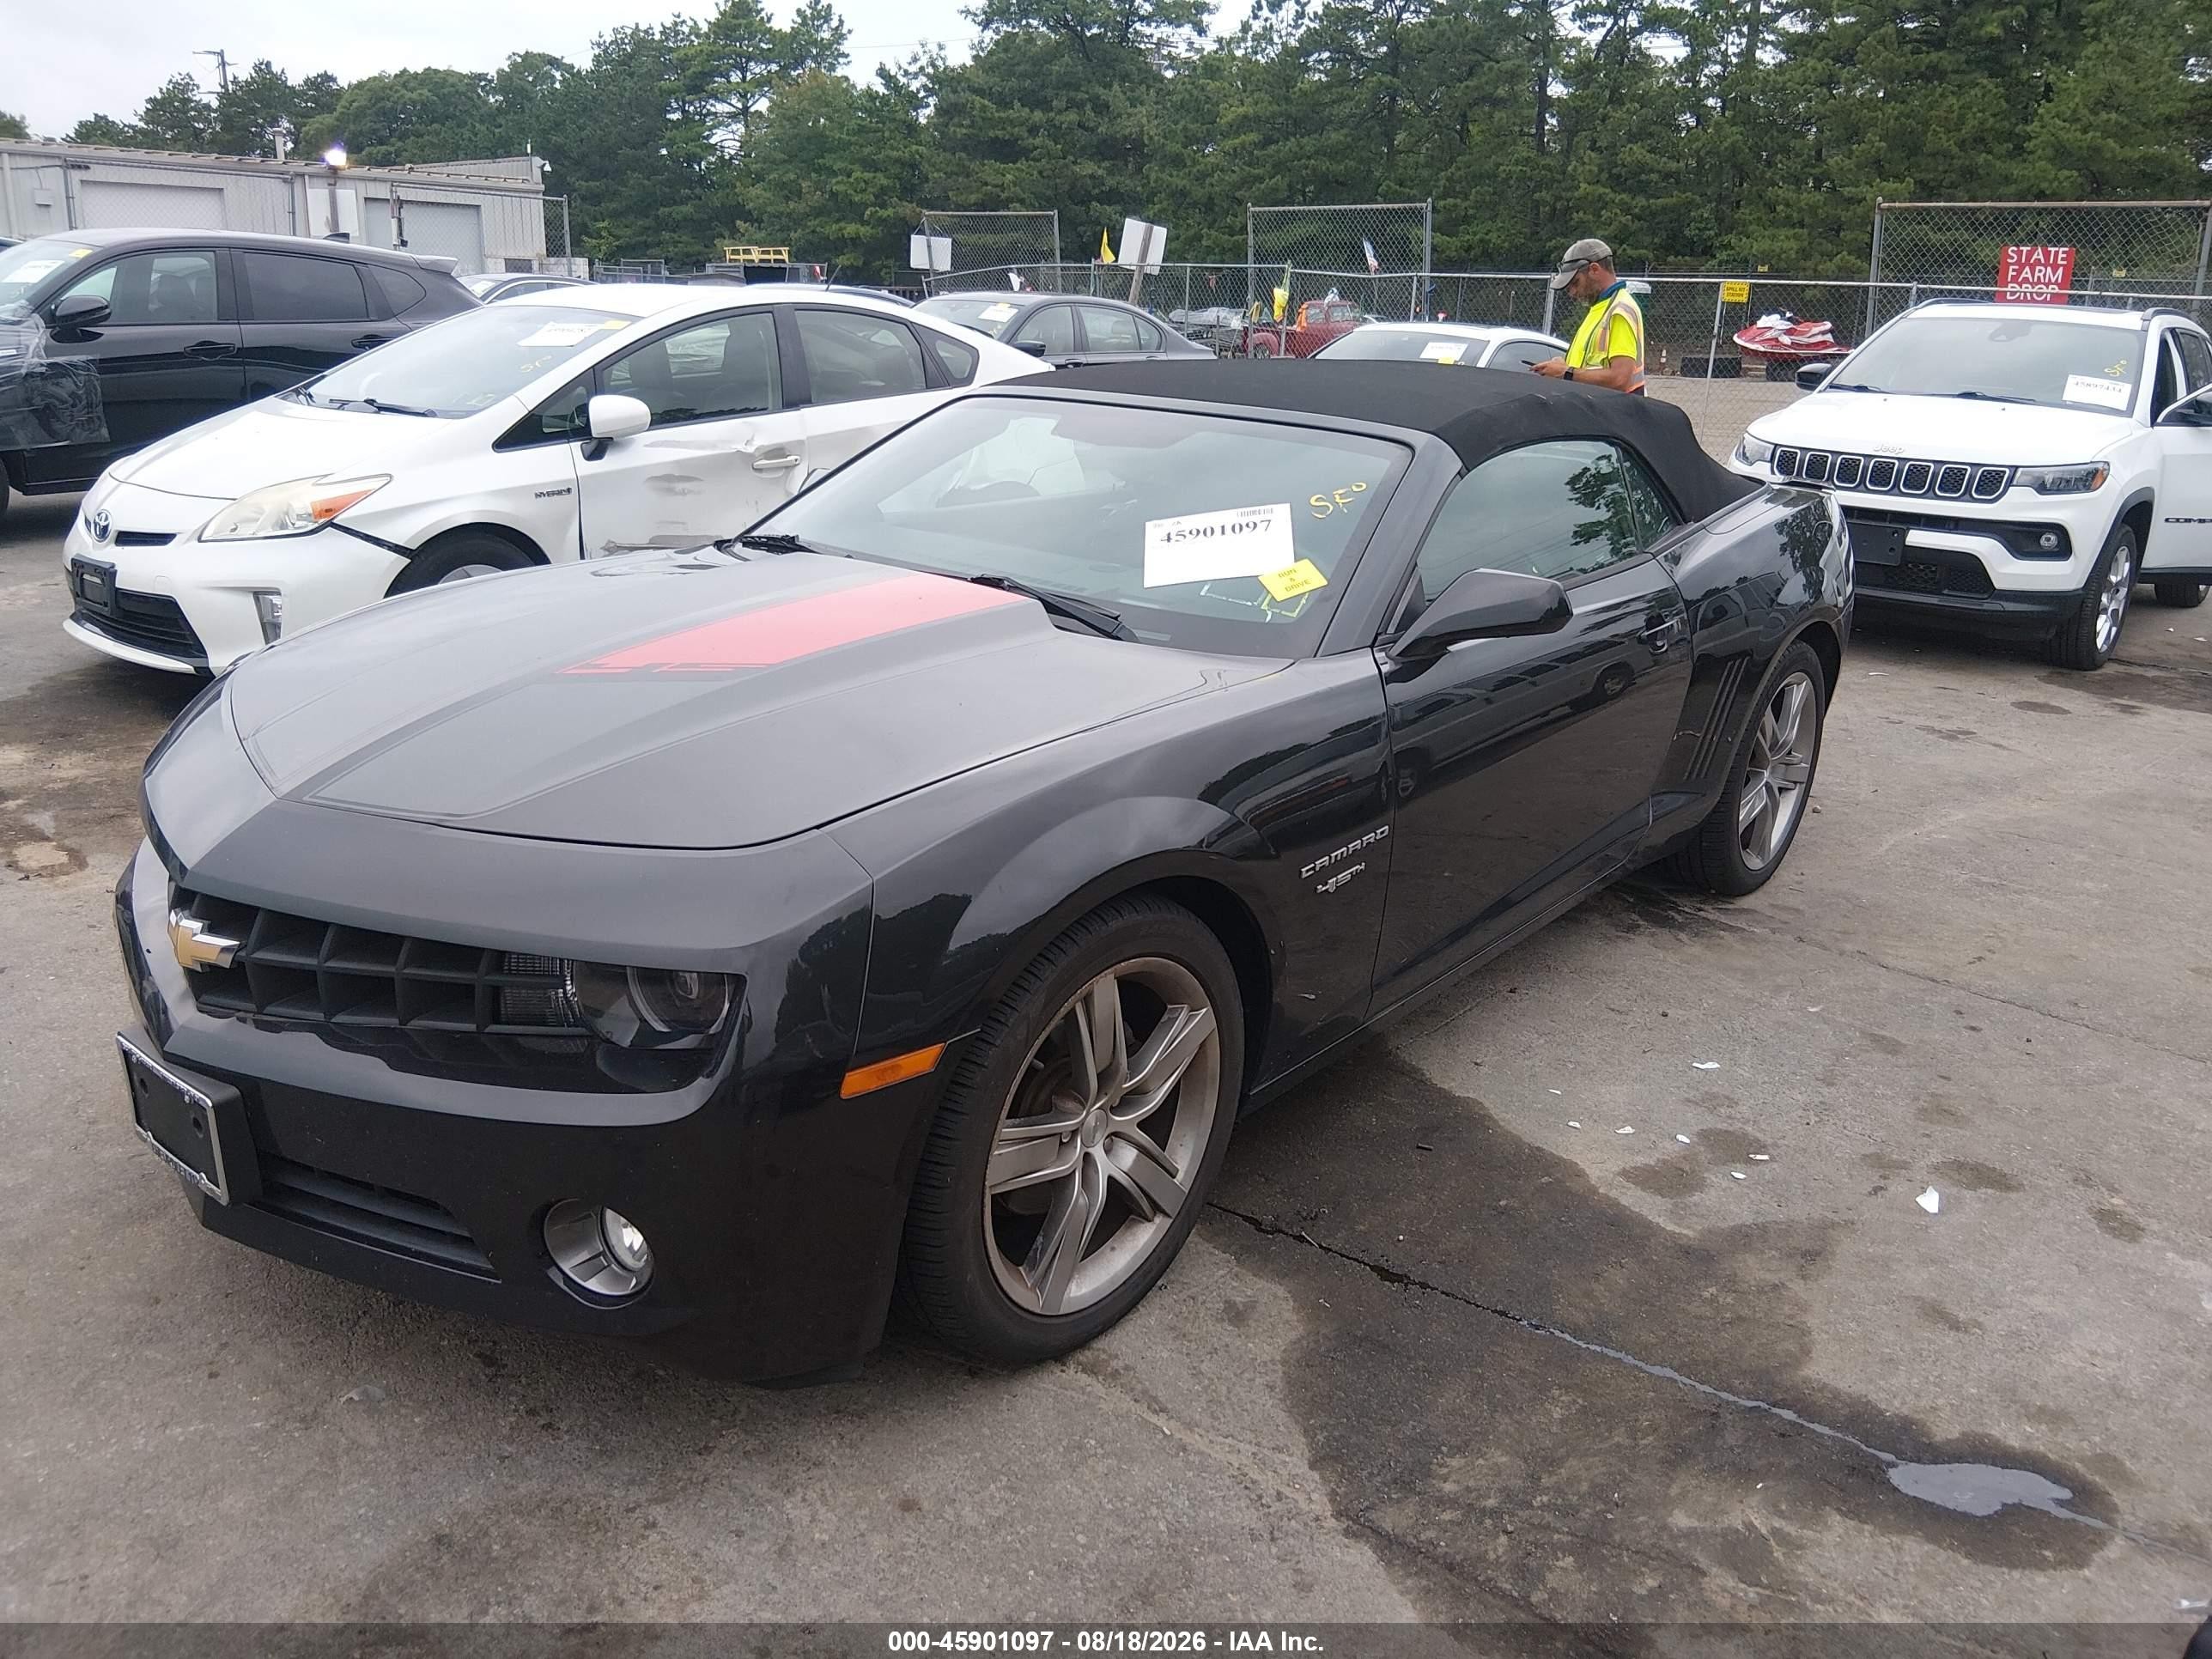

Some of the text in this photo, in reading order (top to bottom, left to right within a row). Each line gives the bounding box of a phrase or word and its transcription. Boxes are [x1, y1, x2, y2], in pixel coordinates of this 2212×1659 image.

[2006, 245, 2069, 264] STATE
[2007, 265, 2064, 283] FARM
[2006, 283, 2060, 301] DROP
[1873, 440, 1905, 455] Jeep
[1160, 518, 1273, 544] 45901097
[1299, 824, 1389, 879] CAMARO
